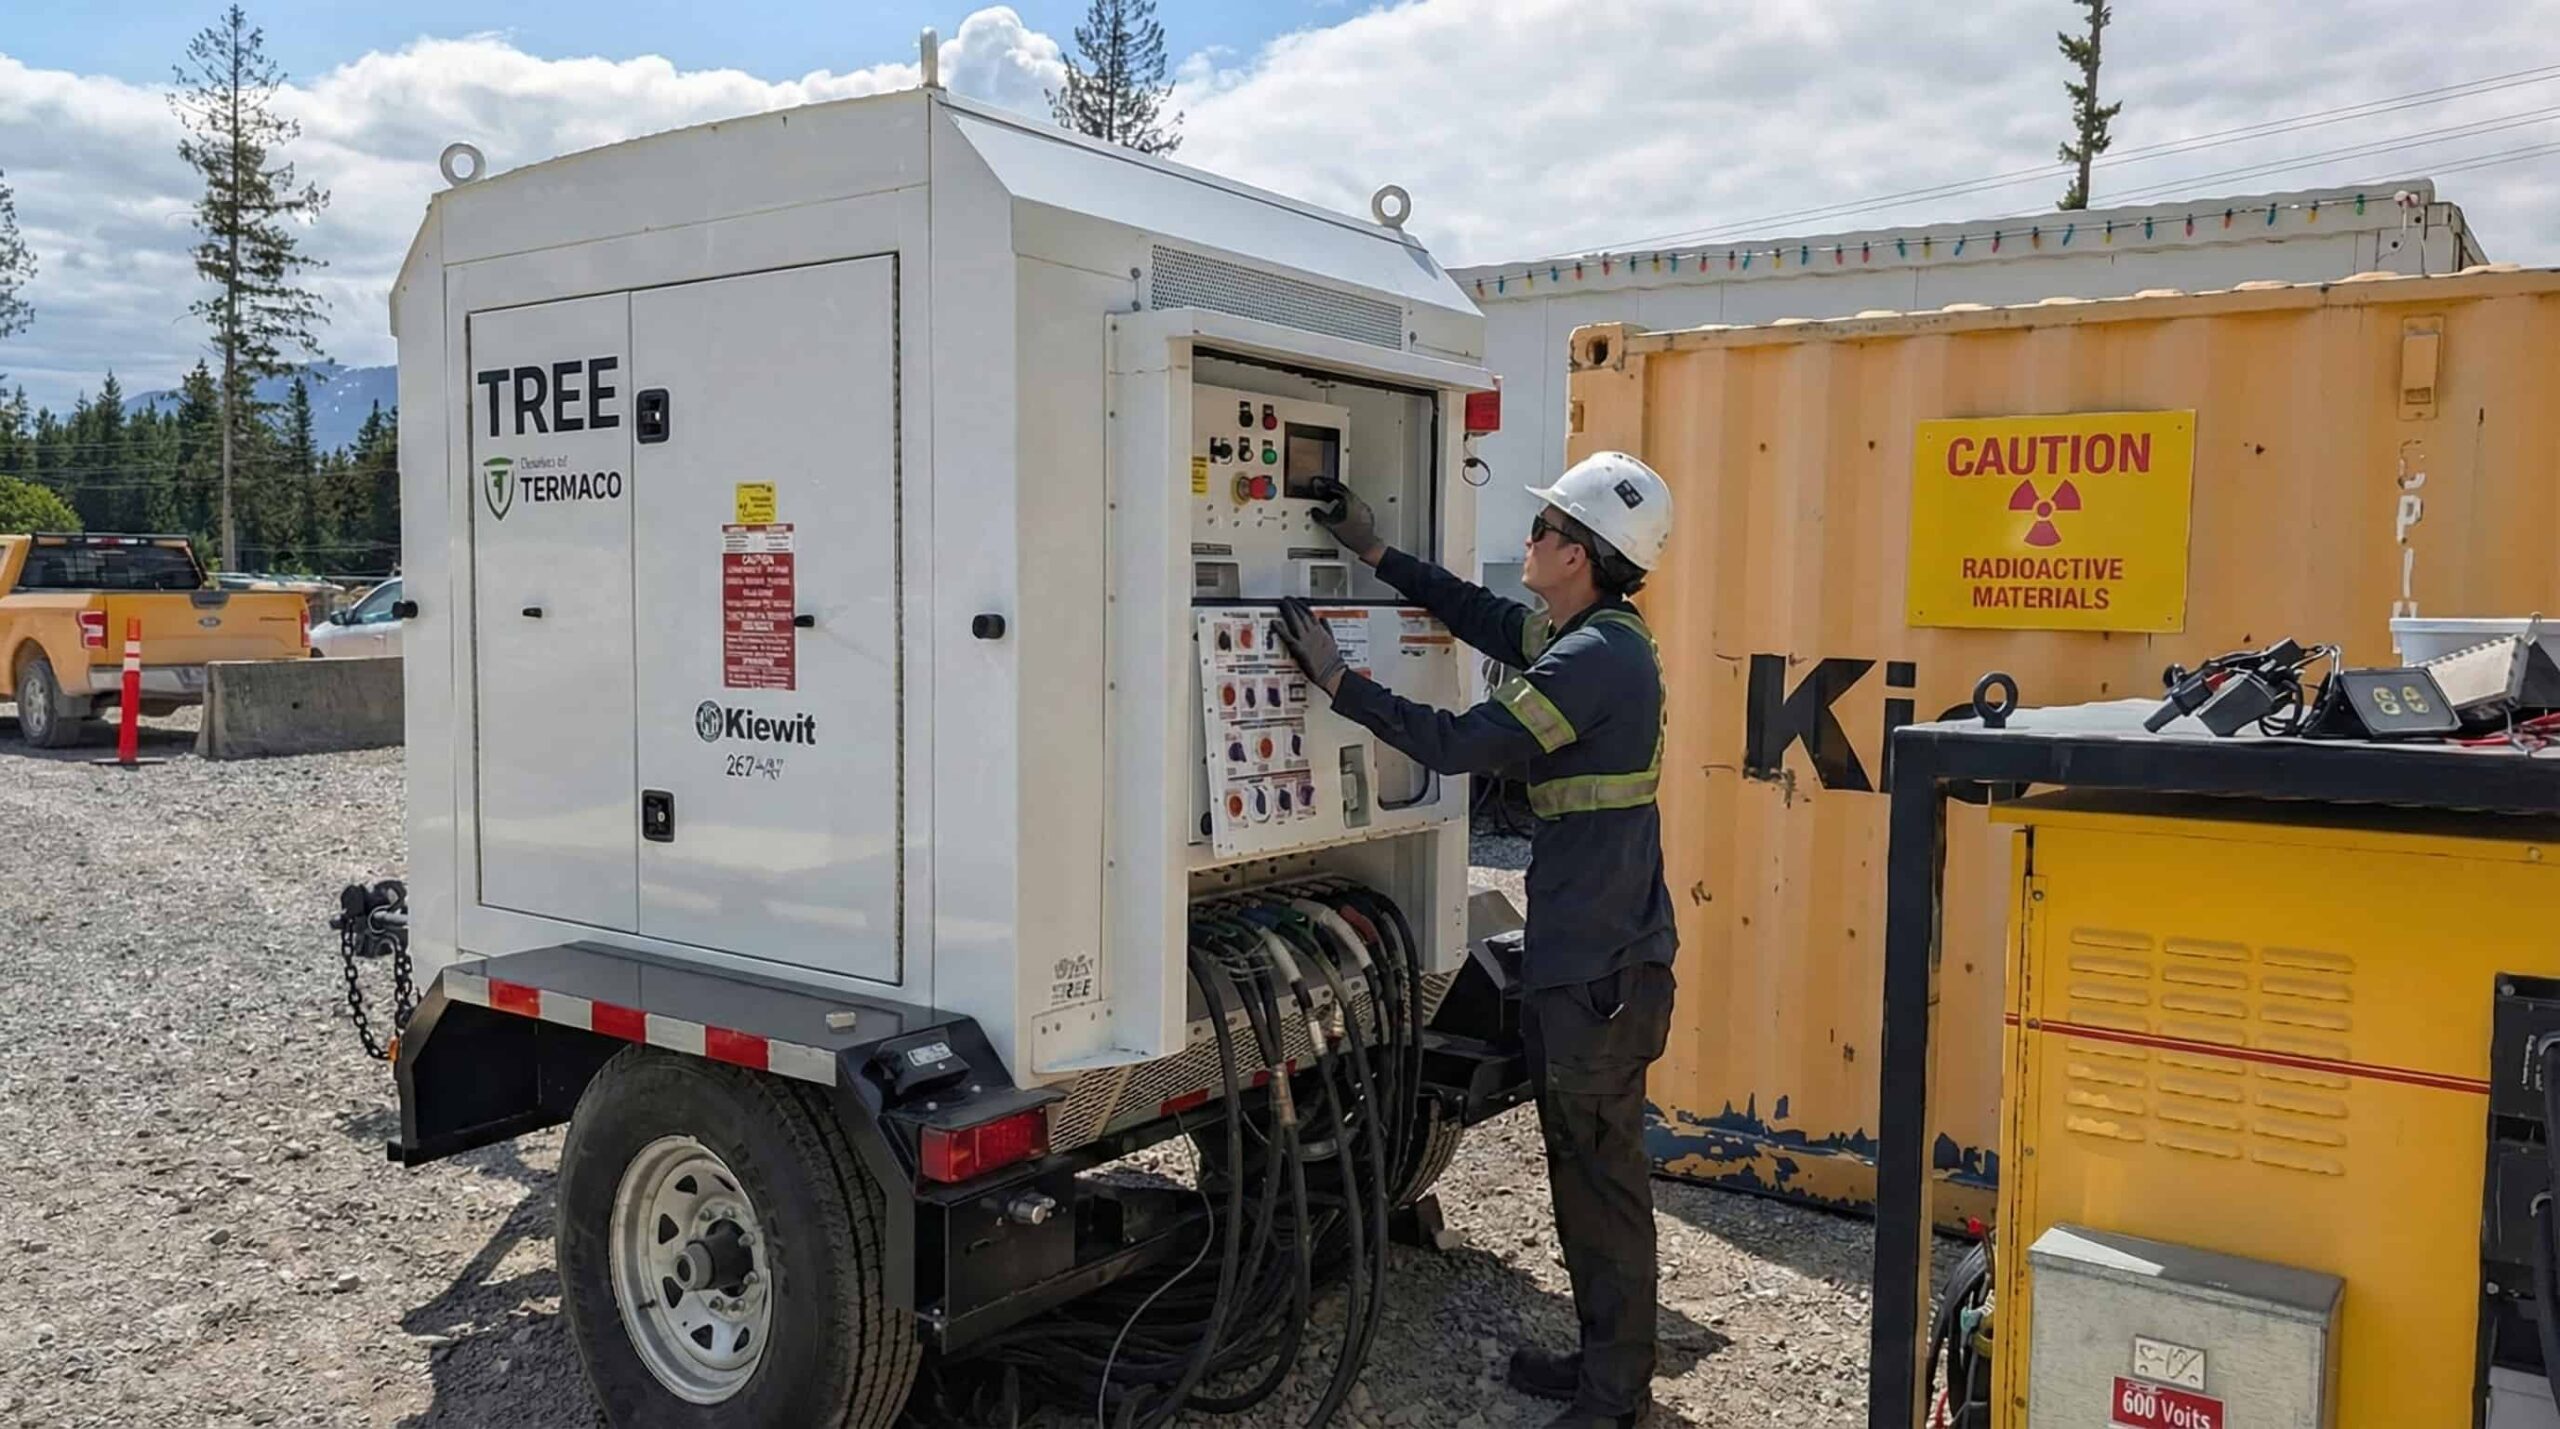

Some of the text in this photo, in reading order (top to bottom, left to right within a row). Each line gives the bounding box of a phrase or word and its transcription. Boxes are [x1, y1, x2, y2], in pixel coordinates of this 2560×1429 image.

[478, 356, 620, 437] TREE
[1947, 433, 2150, 476] CAUTION
[520, 472, 622, 503] TERMACO
[1962, 557, 2123, 581] RADIOACTIVE
[1972, 586, 2110, 610] MATERIALS
[725, 707, 816, 745] Kiewit
[2122, 1389, 2156, 1420] 600
